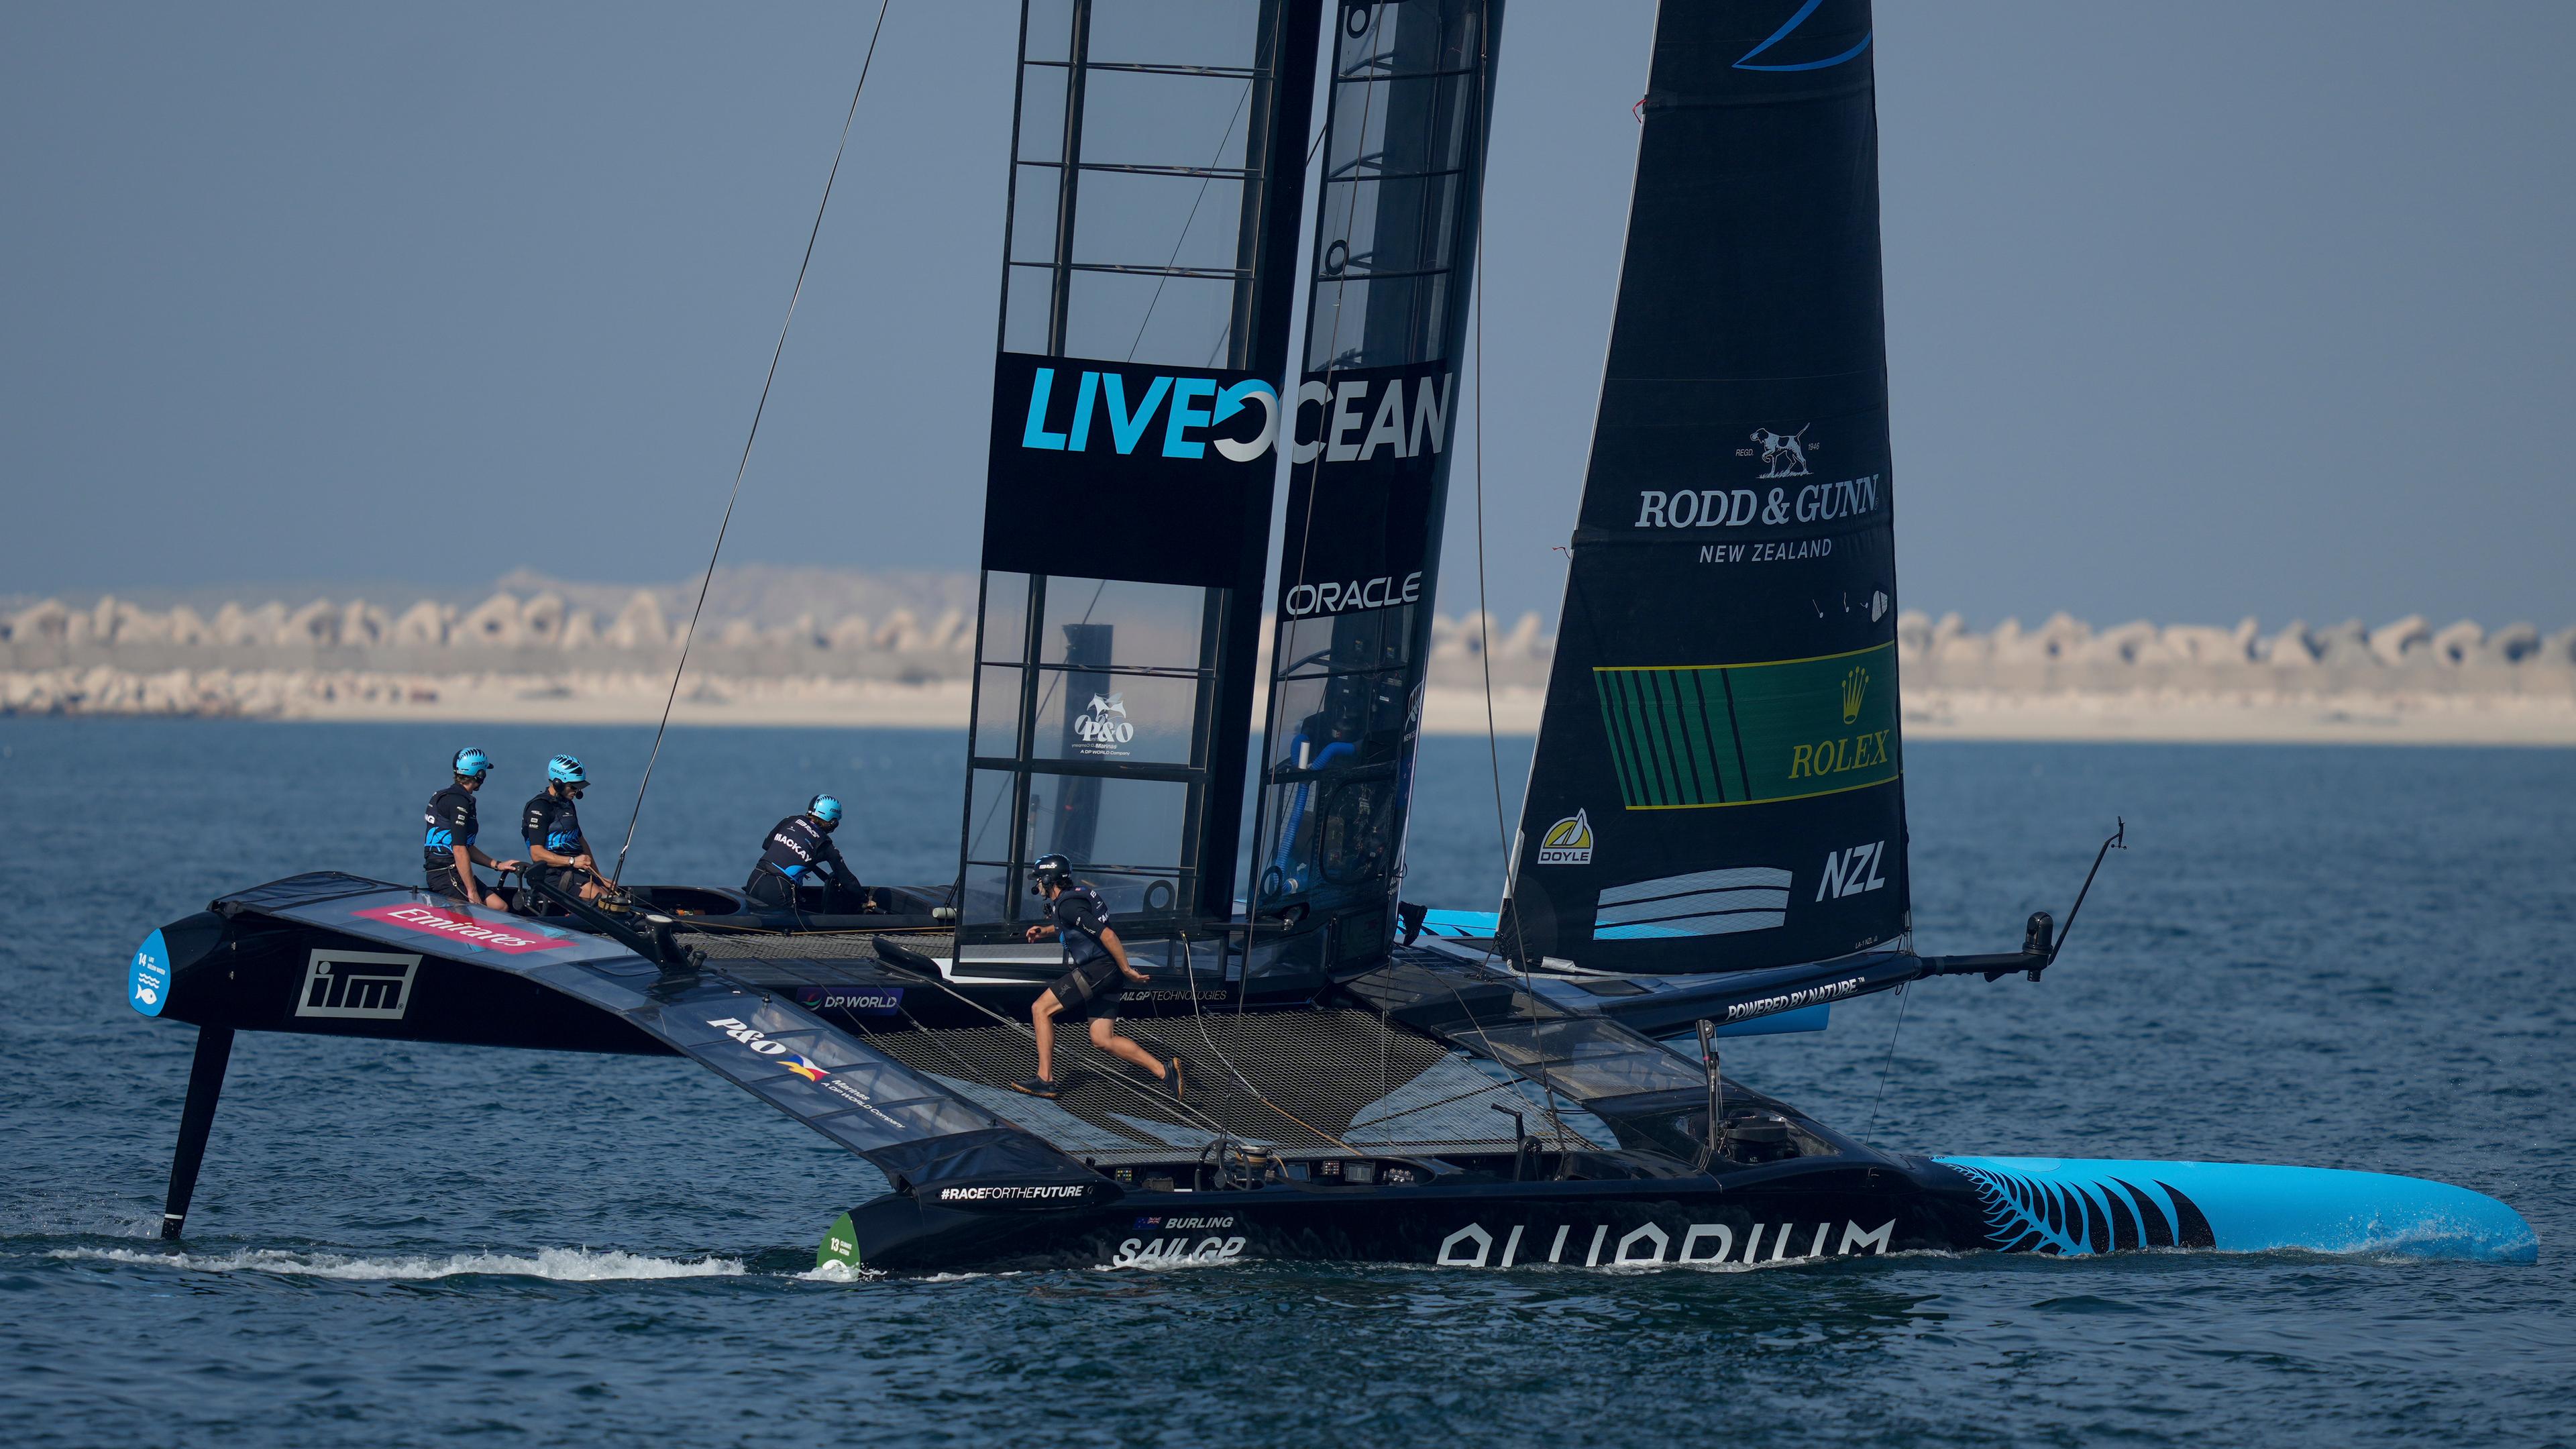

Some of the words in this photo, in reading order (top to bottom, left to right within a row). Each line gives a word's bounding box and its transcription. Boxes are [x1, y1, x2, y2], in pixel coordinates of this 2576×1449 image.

[1735, 449, 1754, 457] REGD.
[1808, 442, 1820, 451] 1946
[1635, 488, 1757, 528] RODD
[1762, 487, 1789, 526] &
[1699, 544, 1746, 564] NEW
[1752, 538, 1832, 562] ZEALAND
[1285, 571, 1423, 616] ORACLE
[1082, 721, 1134, 743] P&O
[1788, 729, 1890, 780] ROLEX
[773, 833, 812, 863] MACKAY
[1540, 852, 1590, 861] DOYLE
[1815, 840, 1885, 903] NZL
[388, 908, 536, 948] Emirates
[138, 953, 147, 967] 14
[824, 996, 845, 1008] DP
[847, 996, 897, 1008] WORLD
[1152, 990, 1227, 1001] TECHNOLOGIES
[1725, 996, 1789, 1021] POWERED
[1789, 989, 1808, 1008] BY
[706, 1017, 787, 1055] P&O
[832, 1079, 870, 1101] Marinas
[828, 1085, 843, 1093] DP
[841, 1092, 873, 1110] WORLD
[870, 1108, 906, 1128] Company
[941, 1185, 1083, 1200] #RACEFORTHEFUTURE
[1165, 1216, 1234, 1229] BURLING
[830, 1237, 840, 1252] 13
